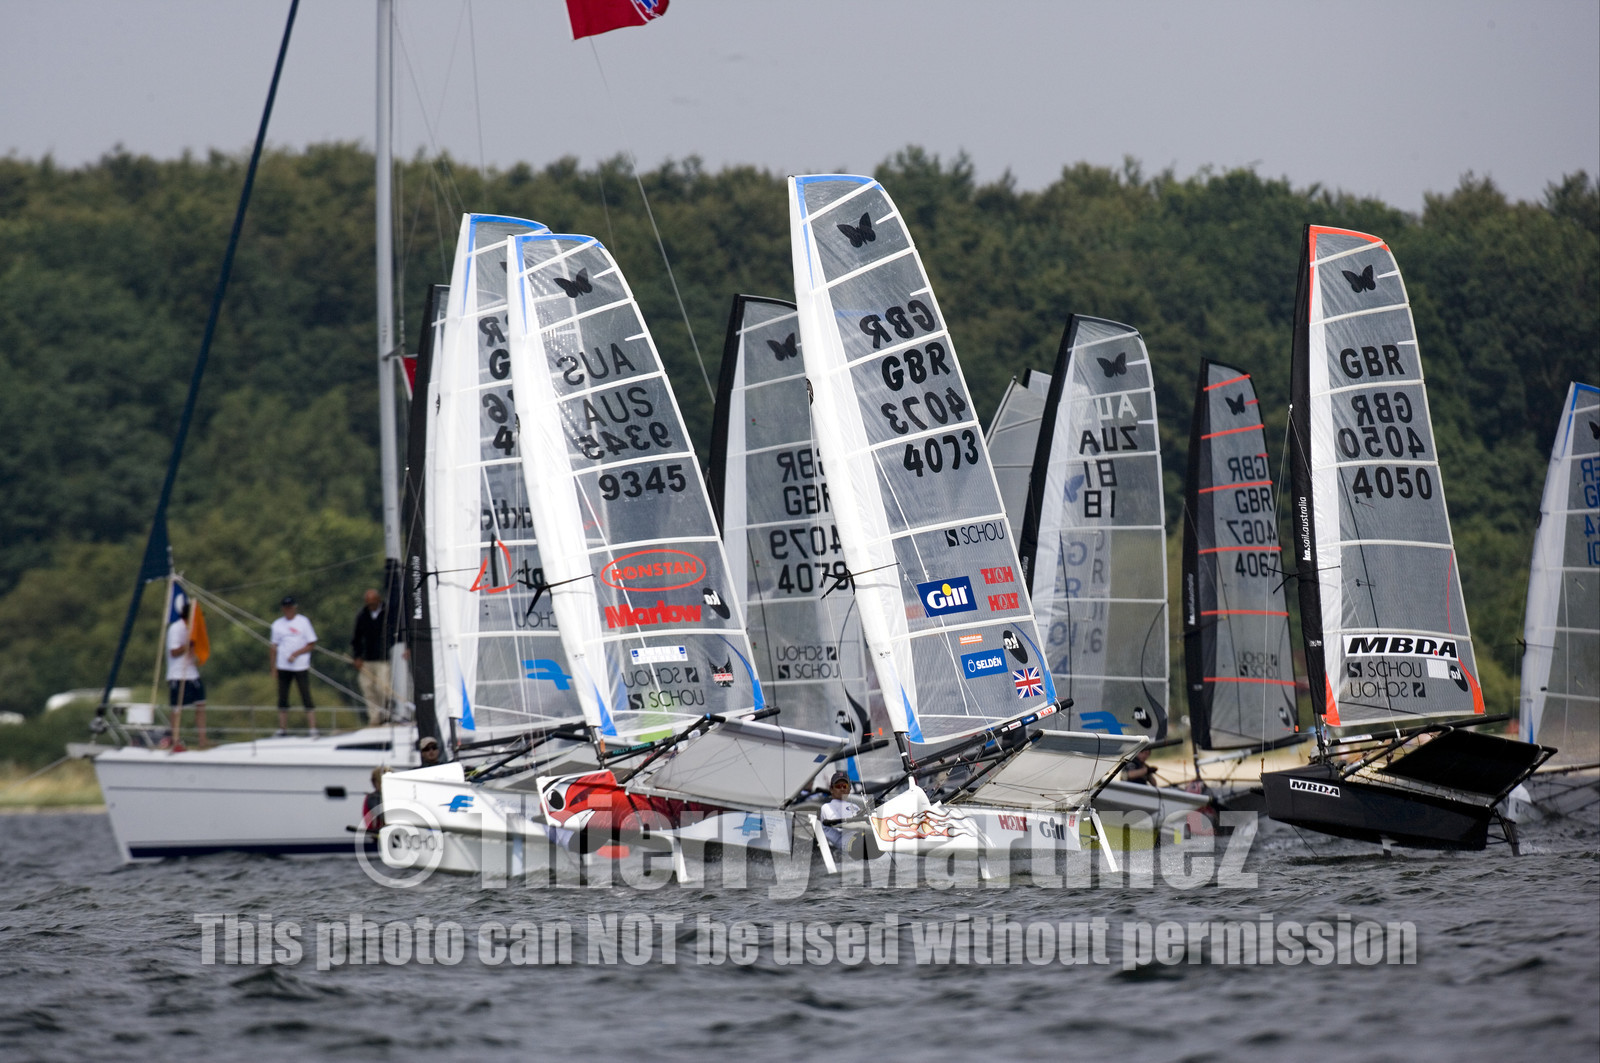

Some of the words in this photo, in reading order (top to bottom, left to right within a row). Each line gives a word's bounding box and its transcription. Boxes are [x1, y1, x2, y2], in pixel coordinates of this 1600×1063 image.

[881, 341, 951, 392] GBR
[1339, 344, 1405, 379] GBR
[582, 386, 654, 430] AUS
[903, 429, 979, 478] 4073
[598, 464, 686, 501] 9345
[1352, 466, 1432, 500] 4050
[1234, 486, 1272, 514] GBR
[960, 521, 1005, 545] SCHOU
[611, 561, 698, 582] RONSTAN
[1235, 551, 1279, 578] 4067
[926, 583, 968, 610] Gill
[987, 592, 1020, 612] HOLT
[604, 600, 702, 629] Marlow
[794, 662, 840, 679] SCHOU
[1367, 660, 1423, 679] SCHOU
[648, 689, 706, 709] SCHOU
[997, 814, 1029, 833] HOLT
[1038, 817, 1066, 841] Gill
